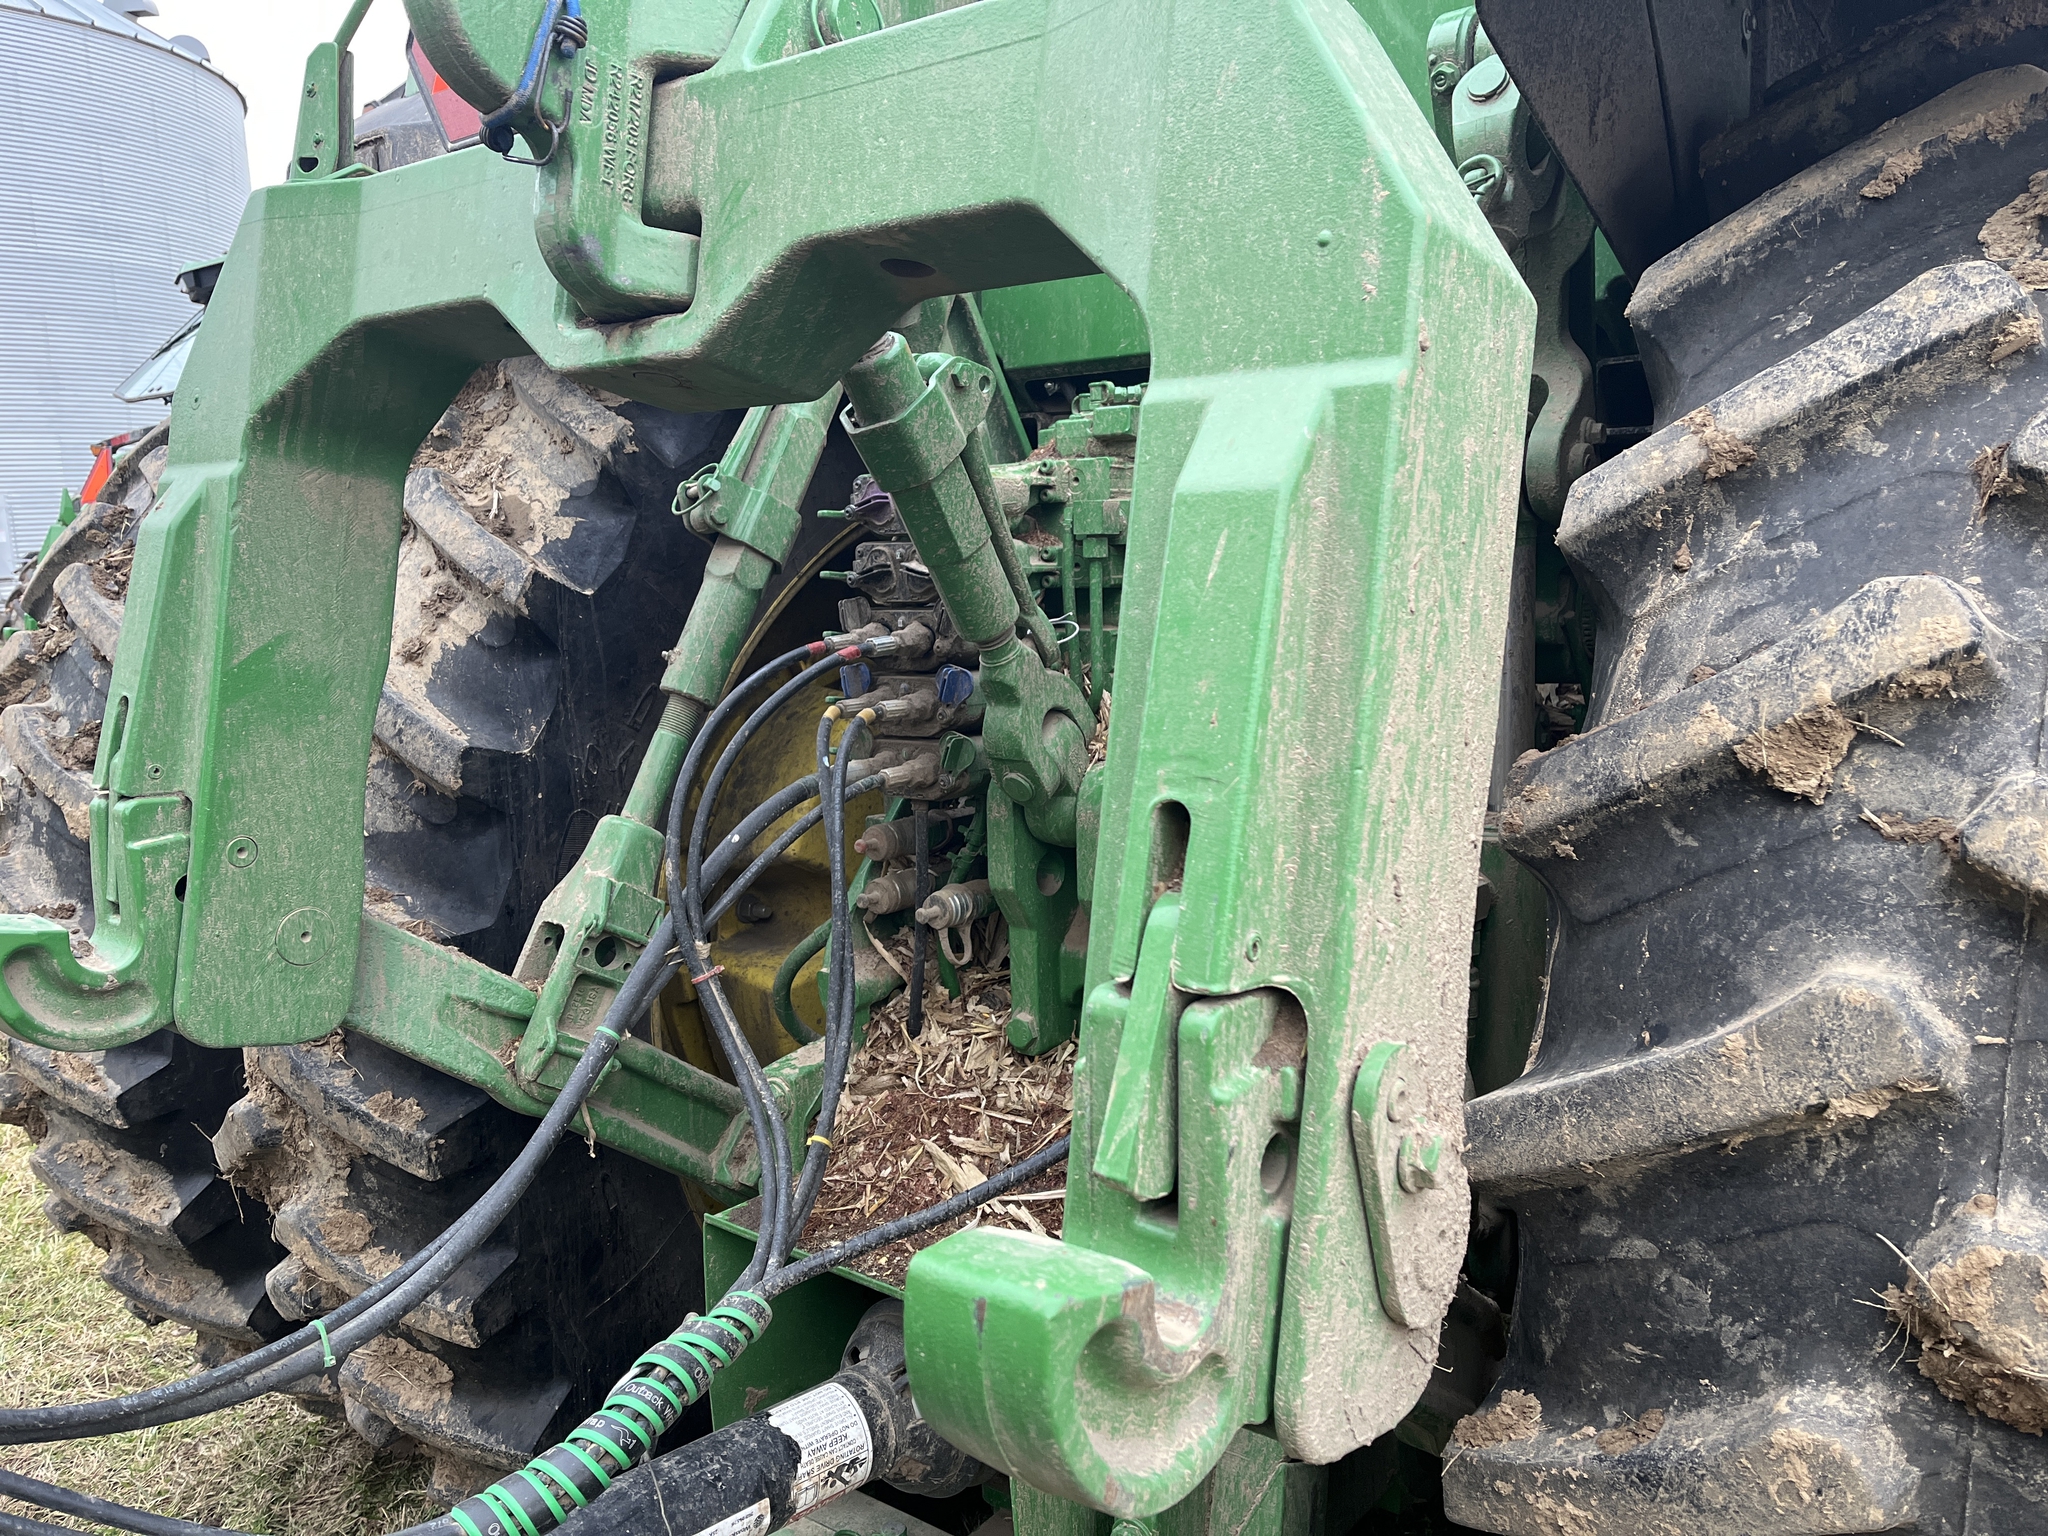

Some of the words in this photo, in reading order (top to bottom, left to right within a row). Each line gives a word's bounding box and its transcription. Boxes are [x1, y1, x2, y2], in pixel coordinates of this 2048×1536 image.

[625, 1383, 664, 1409] Outback
[841, 1424, 850, 1432] NOT
[850, 1420, 858, 1428] DO
[816, 1430, 839, 1444] OPERATE
[829, 1433, 848, 1448] KEEP
[807, 1443, 827, 1457] AWAY
[829, 1447, 838, 1455] CAN
[837, 1437, 857, 1452] CONTACT
[815, 1451, 829, 1462] CAUSE
[836, 1443, 865, 1463] ROTATING
[819, 1460, 835, 1472] DRIVE
